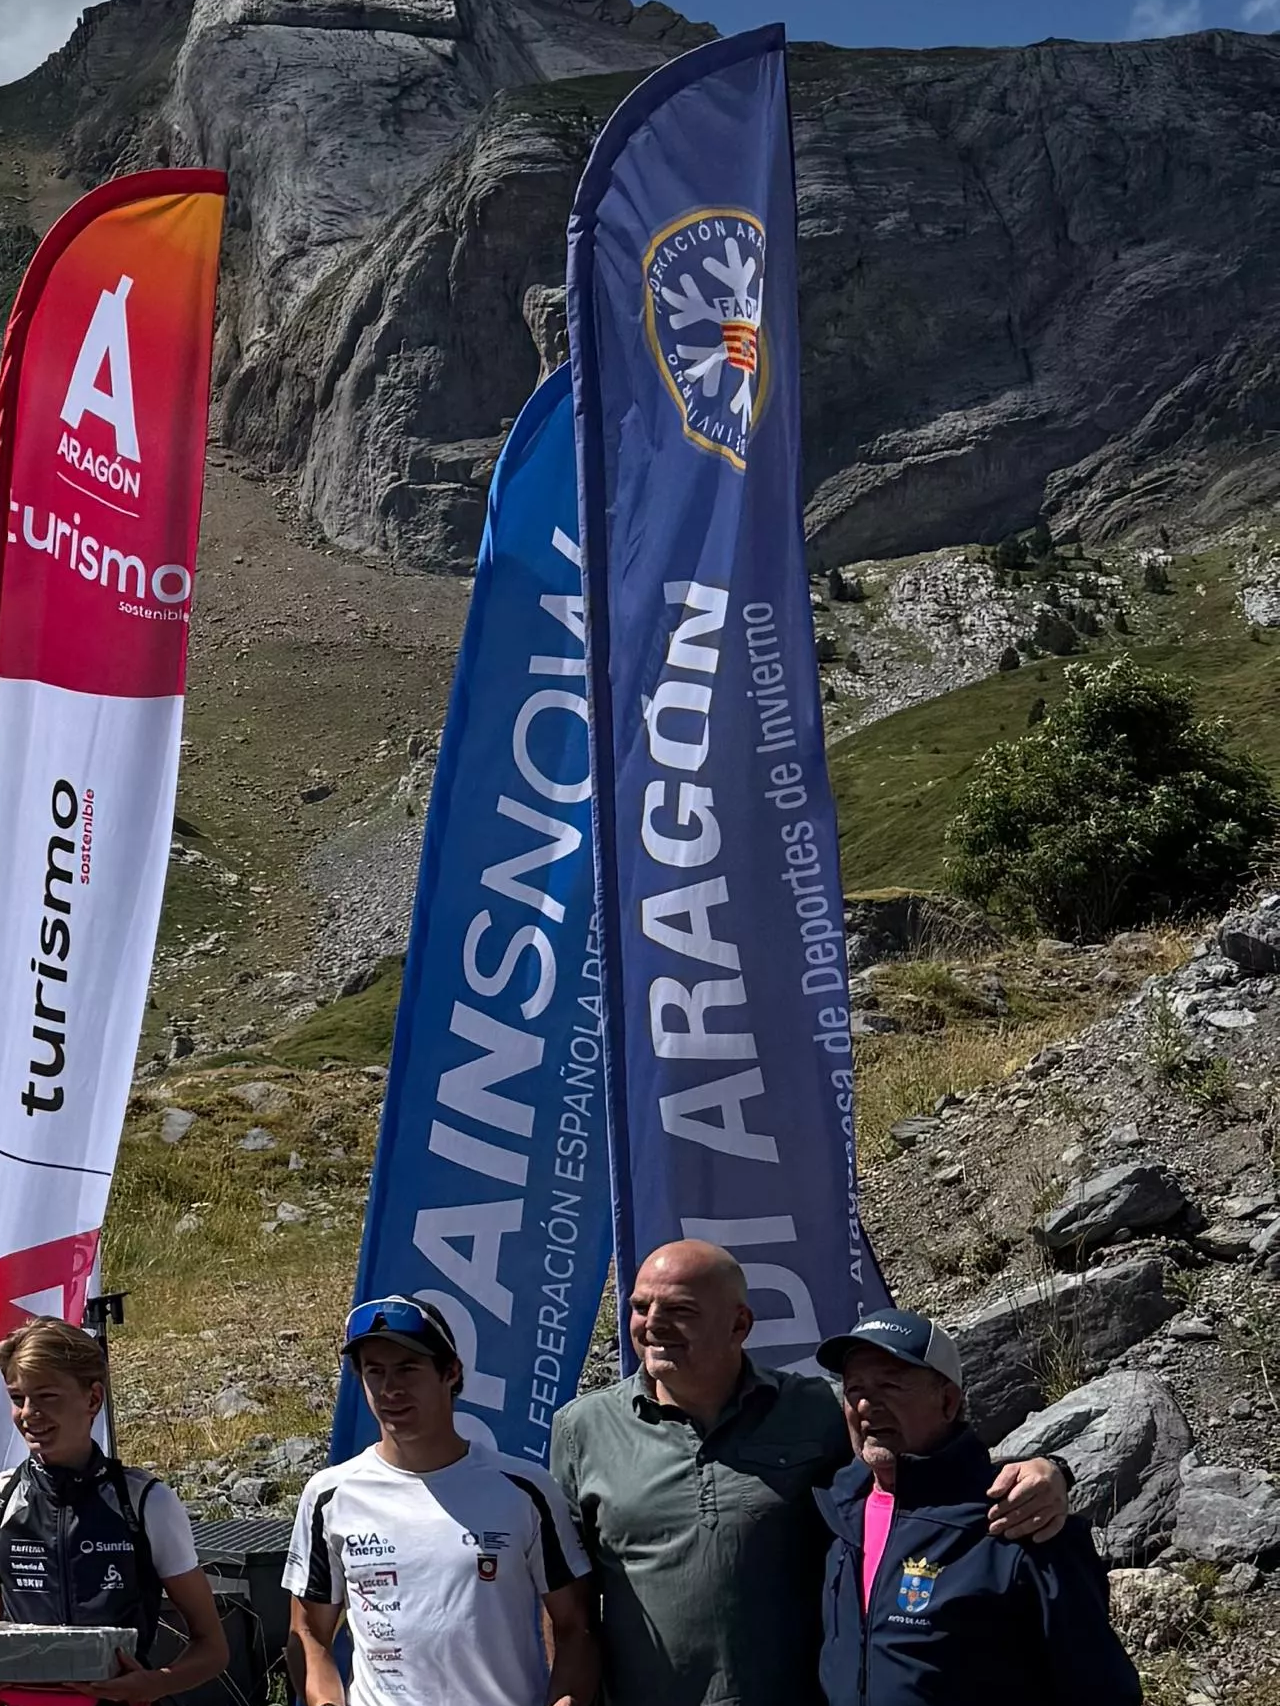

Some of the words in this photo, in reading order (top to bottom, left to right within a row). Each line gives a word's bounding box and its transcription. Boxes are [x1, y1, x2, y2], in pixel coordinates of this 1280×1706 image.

[57, 431, 141, 498] ARAGÓN
[742, 601, 798, 754] Invierno
[80, 788, 95, 886] sostenible
[765, 762, 806, 810] de
[20, 778, 78, 1117] turismo
[781, 821, 843, 996] Deportes
[555, 996, 604, 1181] ESPAÑOLA
[530, 1190, 582, 1429] FEDERACIÓN
[345, 1533, 380, 1548] CVA
